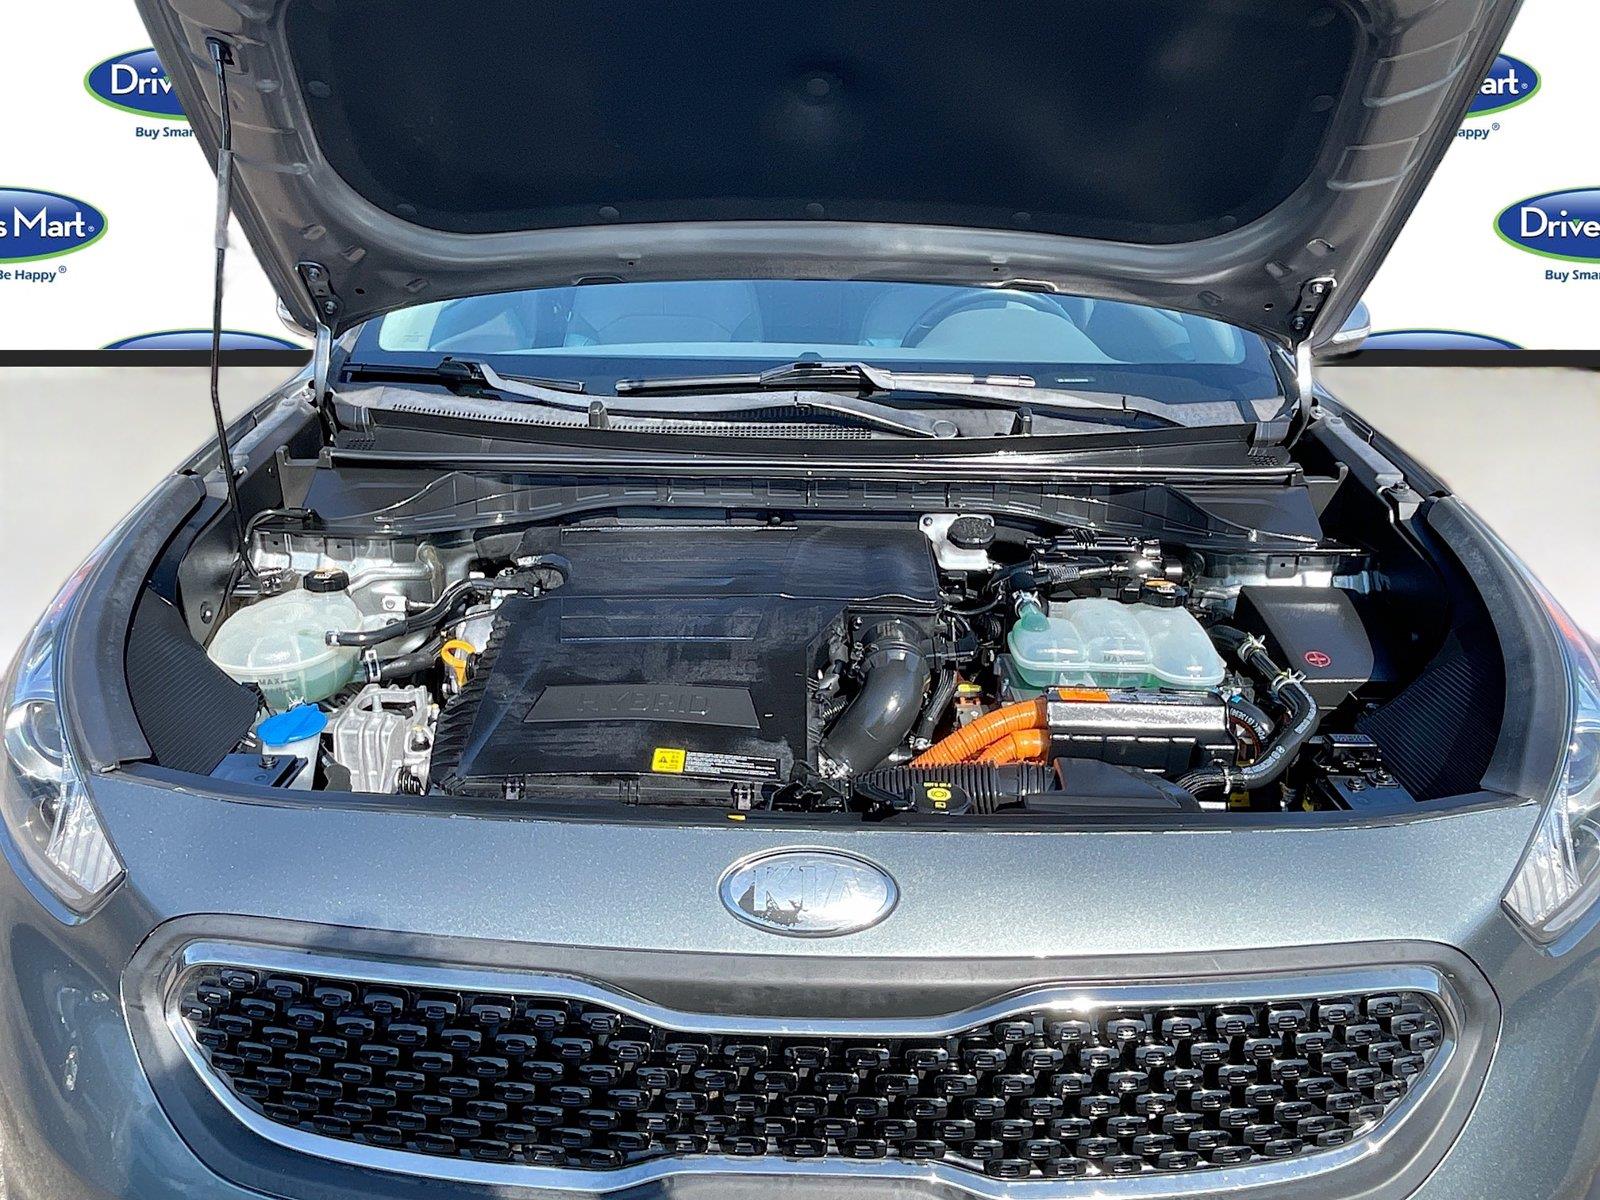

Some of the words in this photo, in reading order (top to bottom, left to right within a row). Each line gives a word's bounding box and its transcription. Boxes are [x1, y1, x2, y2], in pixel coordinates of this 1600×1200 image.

[111, 63, 172, 95] Driv
[1478, 68, 1519, 95] art
[135, 127, 160, 140] Buy
[162, 127, 195, 137] Smar
[1456, 128, 1490, 140] appy
[14, 206, 86, 237] Mart
[1520, 206, 1600, 238] Drive
[15, 269, 57, 283] Happy
[1545, 269, 1570, 283] Buy
[1572, 269, 1600, 280] Sma
[1103, 654, 1127, 664] MAX
[576, 691, 712, 716] HYBRID
[753, 865, 875, 912] KIA
